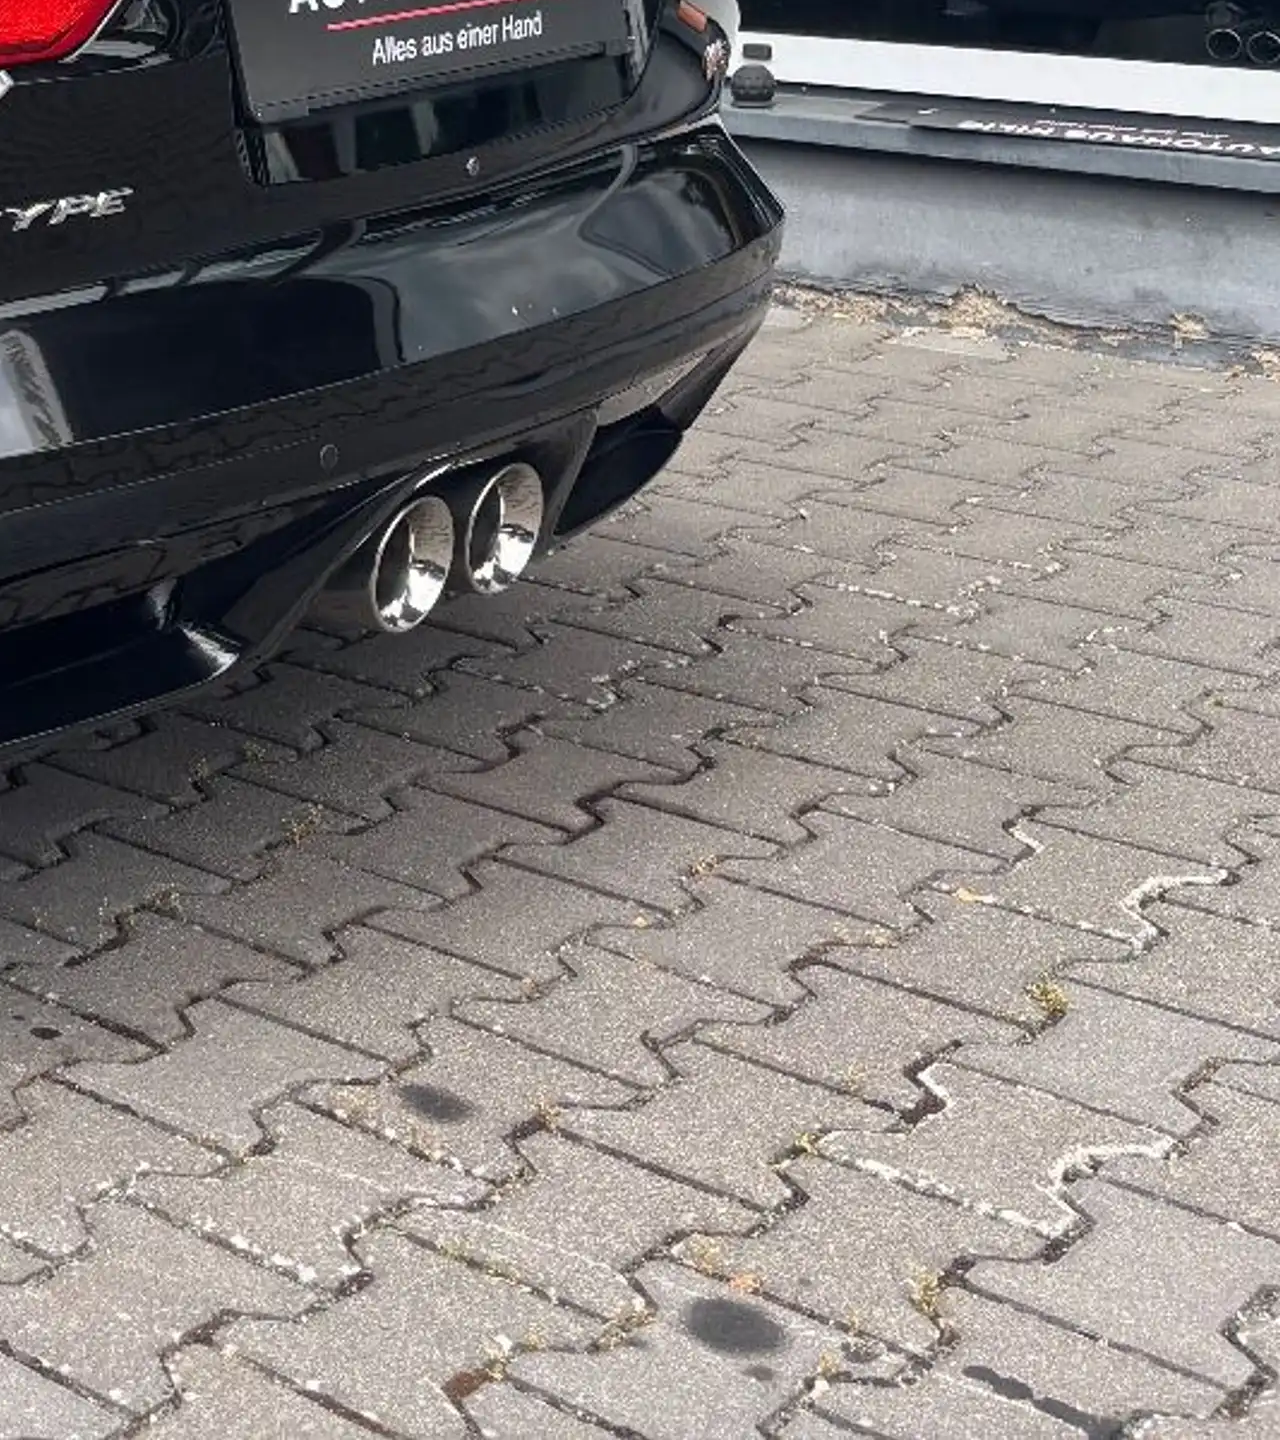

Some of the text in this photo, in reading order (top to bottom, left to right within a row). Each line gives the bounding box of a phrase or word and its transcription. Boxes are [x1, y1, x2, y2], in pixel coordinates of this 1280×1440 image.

[372, 10, 543, 66] Alles aus einer Hand
